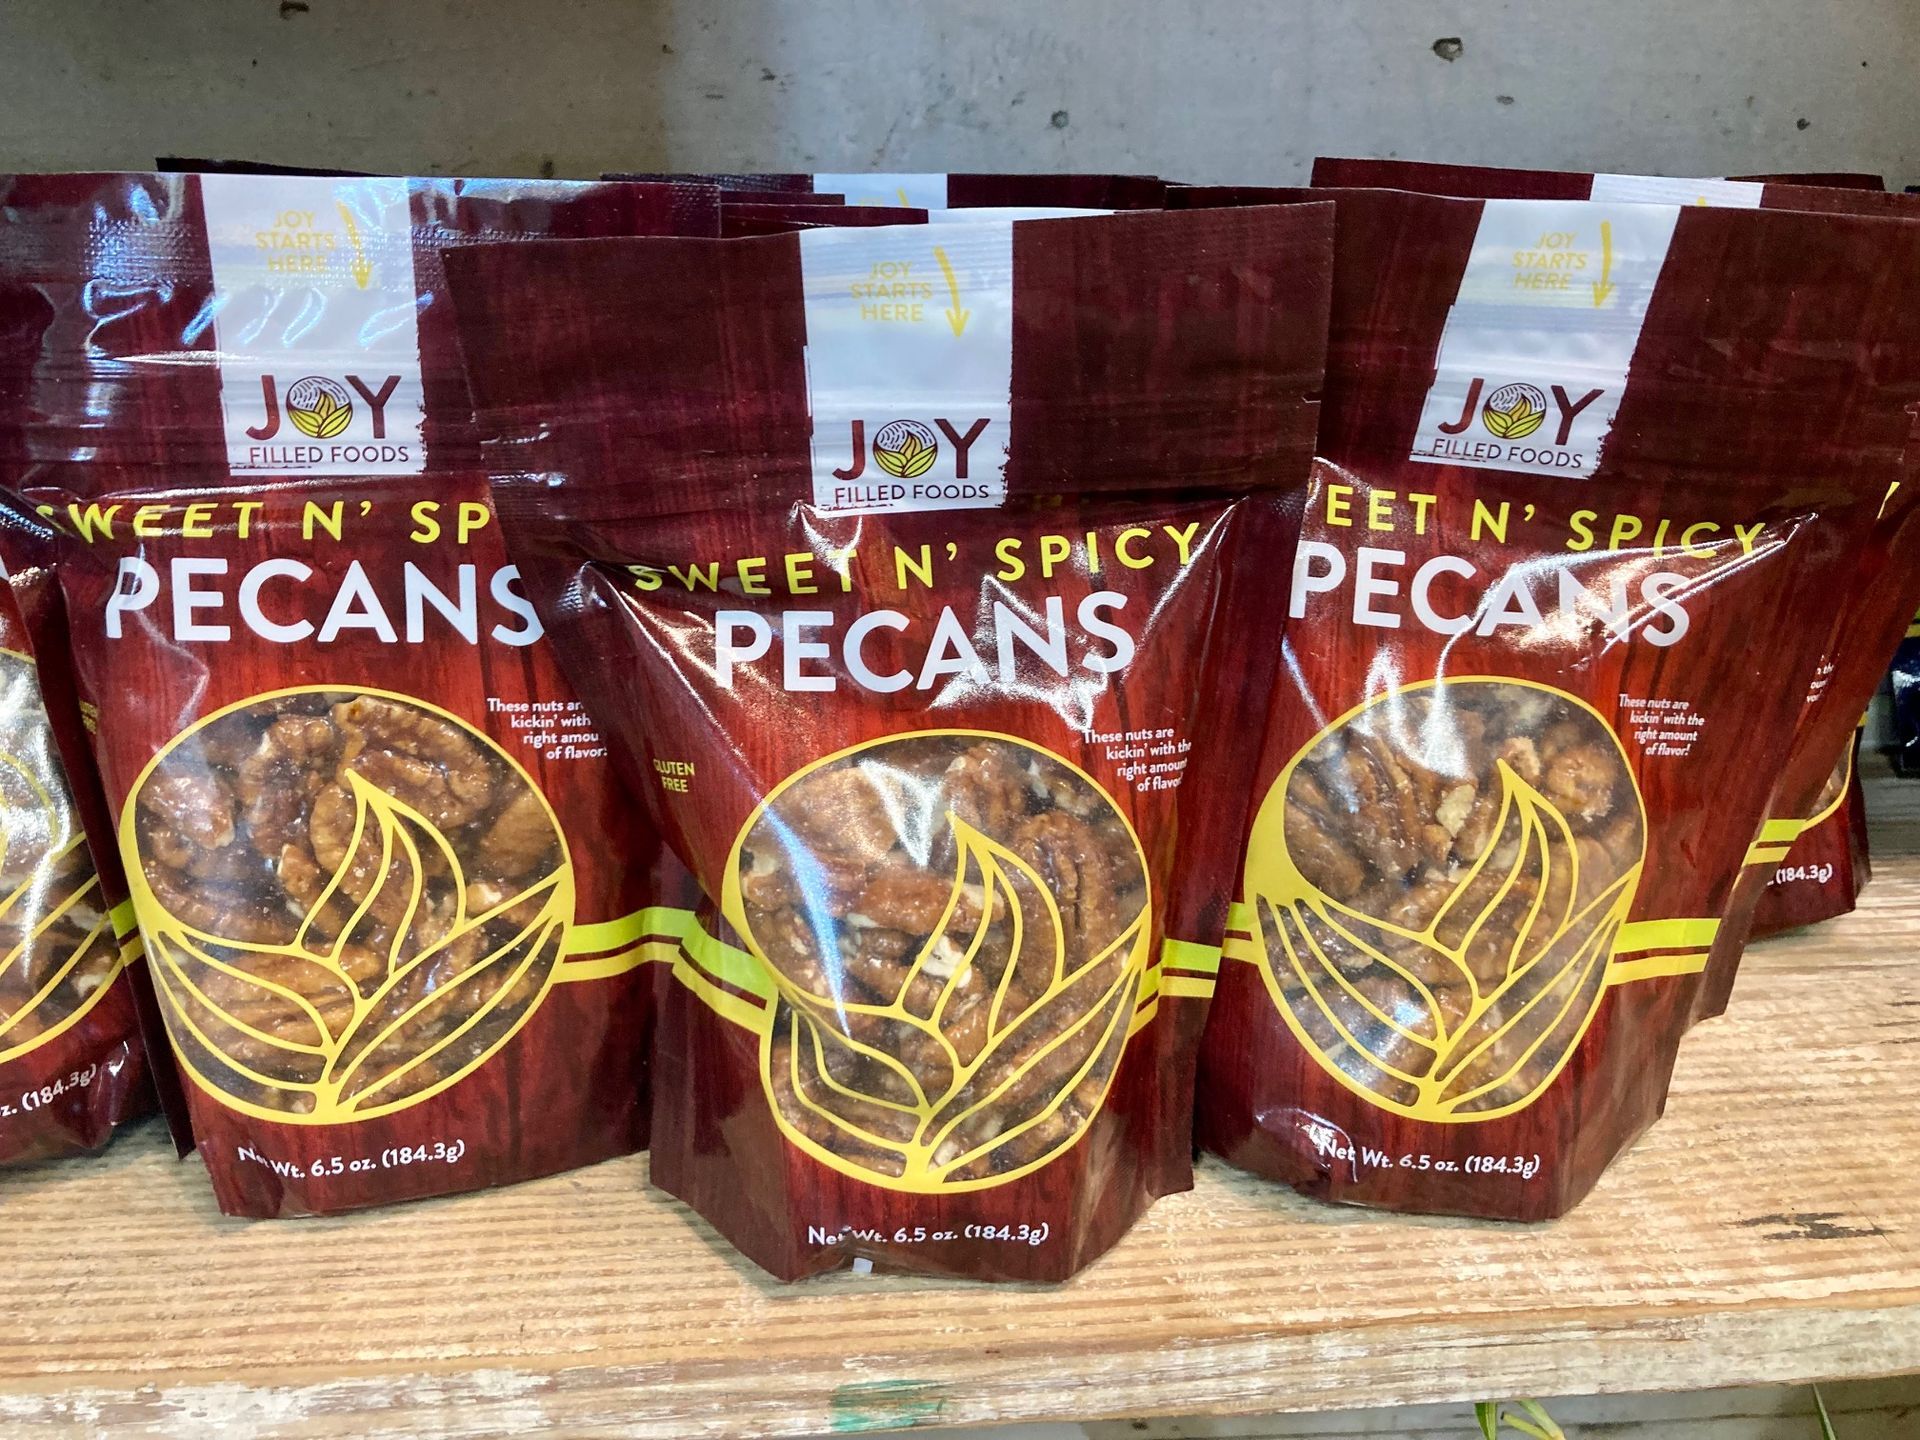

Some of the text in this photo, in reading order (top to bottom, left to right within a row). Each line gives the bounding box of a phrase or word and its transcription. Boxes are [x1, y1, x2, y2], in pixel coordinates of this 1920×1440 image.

[275, 210, 316, 228] JOY
[256, 232, 336, 250] STARTS
[1536, 232, 1578, 249] JOY
[268, 255, 327, 273] HERE
[1512, 252, 1587, 270] STARTS
[870, 261, 912, 280] JOY
[1514, 272, 1572, 290] HERE
[852, 282, 934, 299] STARTS
[860, 304, 924, 322] HERE
[246, 374, 402, 440] JOY
[1438, 377, 1605, 446] JOY
[250, 446, 409, 464] FILLED FOODS
[832, 418, 991, 480] JOY
[1434, 438, 1583, 469] FILLED FOODS
[834, 484, 989, 504] FILLED FOODS
[1308, 482, 1438, 535] EET
[1566, 509, 1766, 559] SPICY
[634, 550, 858, 595] SWEET
[997, 522, 1200, 582] SPICY
[106, 557, 546, 647] PECANS
[1288, 540, 1691, 647] PECANS
[714, 591, 1137, 692] PECANS
[486, 698, 584, 712] These nuts ar
[1619, 694, 1690, 710] These nuts are
[561, 713, 592, 727] with
[1664, 712, 1686, 726] with
[1687, 712, 1705, 726] the
[523, 732, 558, 749] right
[1082, 728, 1174, 744] These nuts are
[1634, 726, 1698, 745] right amount
[546, 746, 562, 760] of
[1150, 740, 1176, 756] with
[1646, 742, 1691, 756] of flavor!
[653, 758, 696, 776] GLUTEN
[1117, 761, 1147, 781] right
[661, 776, 689, 793] FREE
[1137, 776, 1151, 792] of
[1776, 862, 1833, 884] (184.3g)
[0, 1063, 96, 1116] z. (184.3g)
[270, 1160, 306, 1178] Wt.
[311, 1156, 344, 1177] 6.5
[349, 1158, 377, 1172] oz.
[382, 1138, 466, 1169] (184.3g)
[1319, 1139, 1541, 1180] Net Wt. 6.5 oz. (184.3g)
[852, 1228, 888, 1243] Wt.
[894, 1226, 926, 1243] 6.5
[932, 1230, 958, 1241] oz.
[964, 1222, 1050, 1246] (184.3g)
